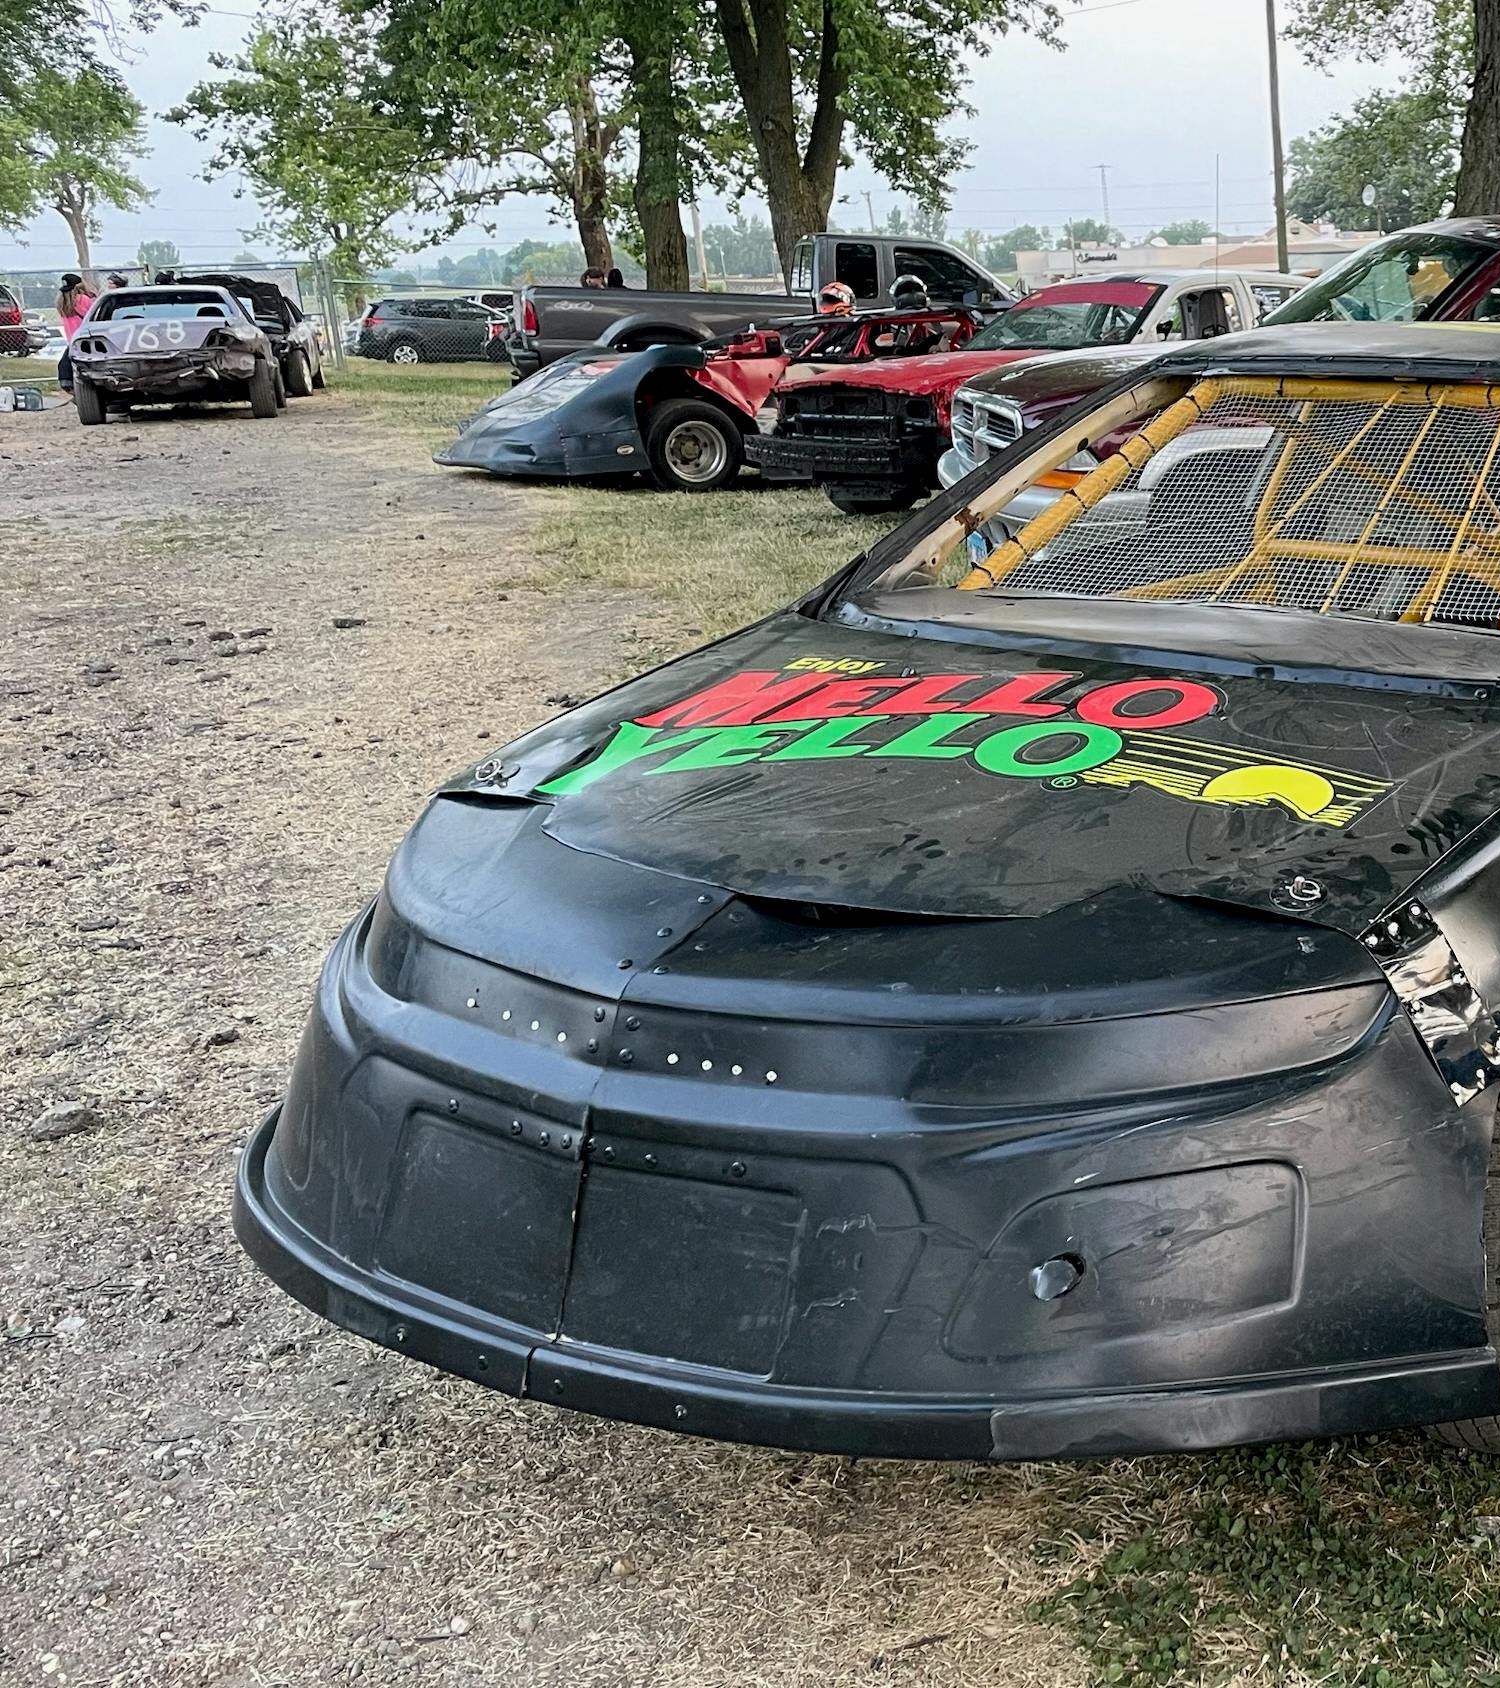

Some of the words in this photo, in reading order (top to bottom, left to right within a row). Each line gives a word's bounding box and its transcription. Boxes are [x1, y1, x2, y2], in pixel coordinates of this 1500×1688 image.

[783, 656, 888, 675] Enjoy
[632, 670, 1220, 731] MELLO
[535, 713, 1124, 796] YELLO
